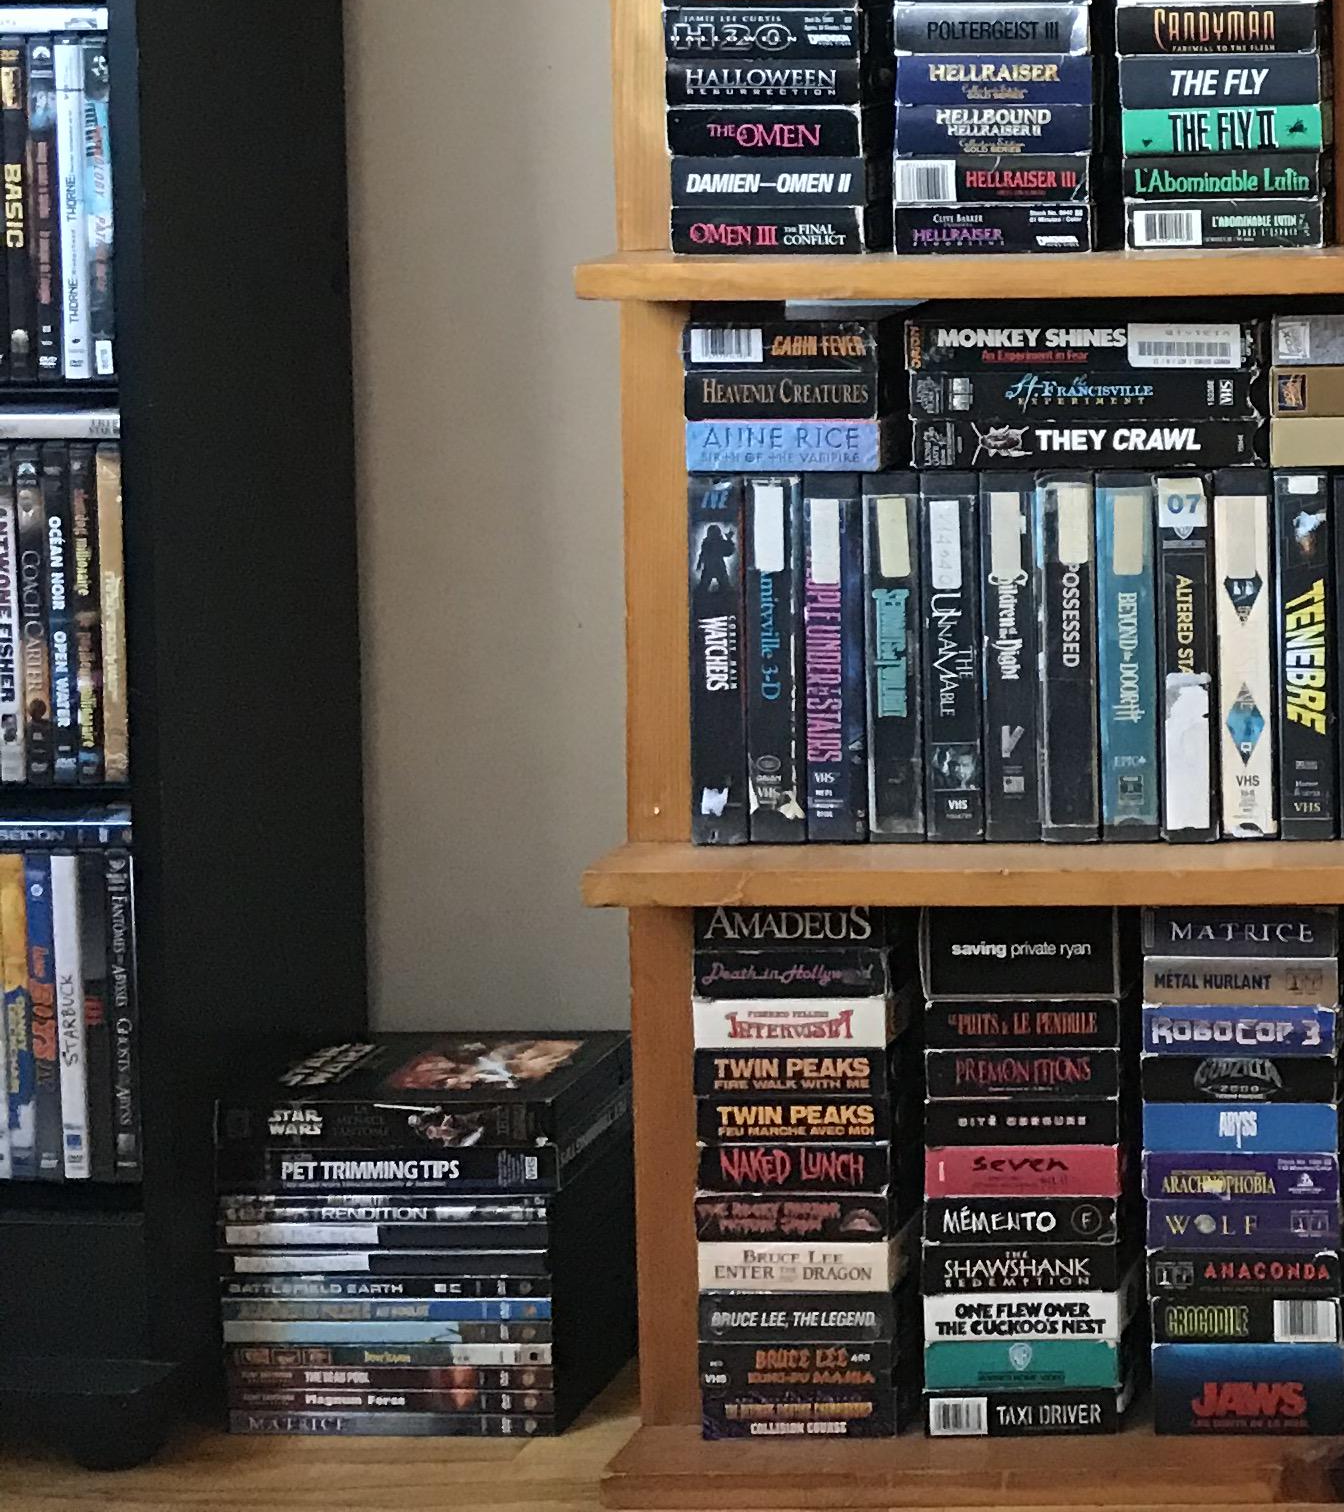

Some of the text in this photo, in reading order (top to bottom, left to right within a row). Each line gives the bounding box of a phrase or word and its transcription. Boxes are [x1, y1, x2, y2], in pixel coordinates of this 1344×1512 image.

[1170, 69, 1268, 95] THE FLY
[4, 164, 24, 248] BASIC
[938, 327, 1127, 348] MONKEY SHINES
[1036, 428, 1200, 452] THEY CRAWL
[51, 572, 65, 610] NOIR
[54, 630, 71, 727] OPEN WATER
[952, 940, 1091, 958] saving private ryan
[65, 973, 82, 1068] STARBUCK
[714, 1058, 870, 1078] TWIN PEAKS
[282, 1160, 459, 1181] PET TRIMMING TIPS
[321, 1206, 428, 1220] RENDITION
[1204, 1262, 1329, 1280] ANACONDA
[1191, 1382, 1306, 1415] JAWS
[996, 1403, 1101, 1425] TAXI DRIVER
